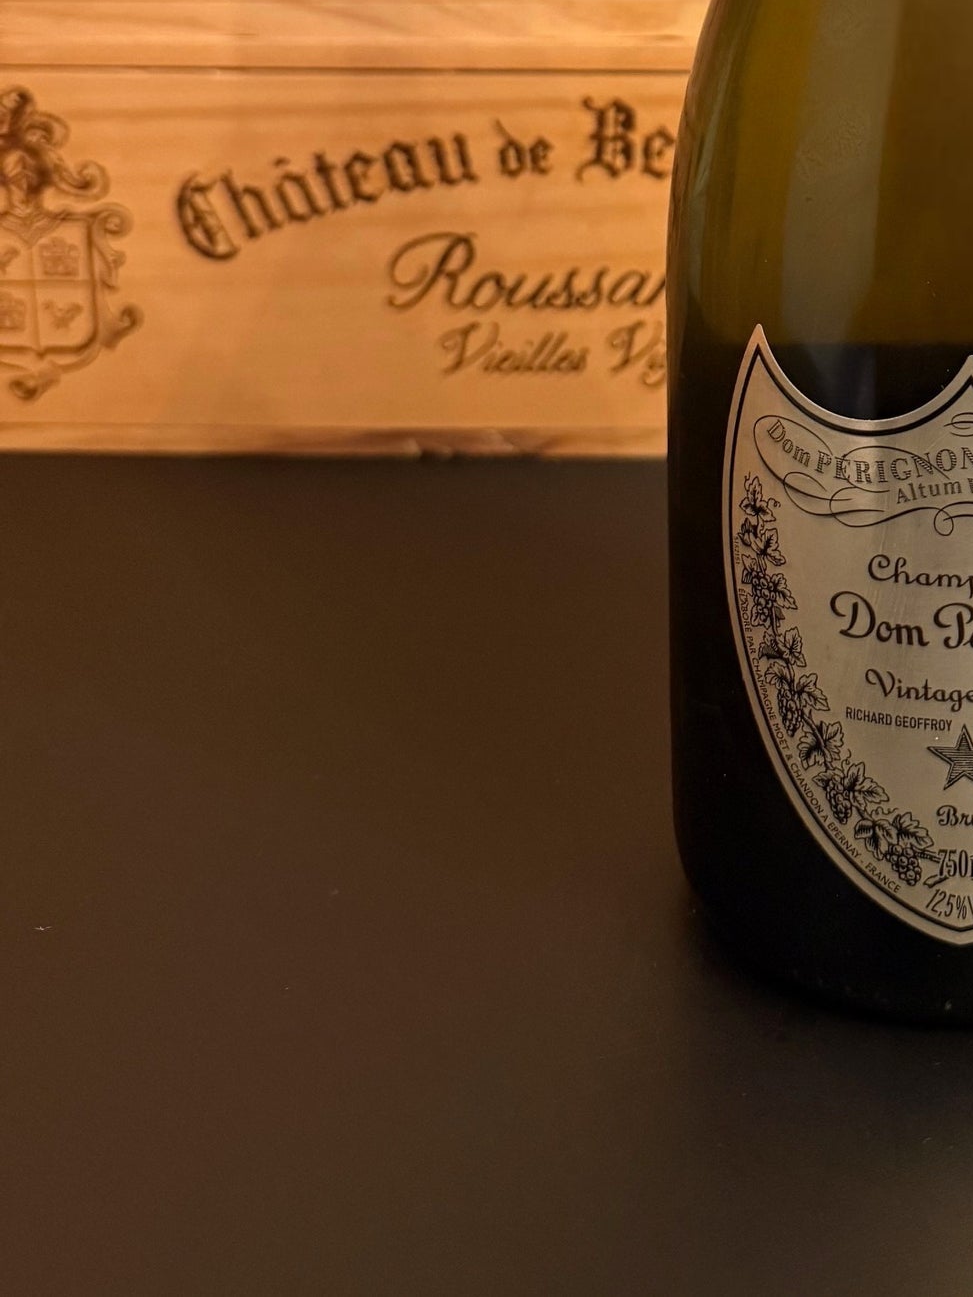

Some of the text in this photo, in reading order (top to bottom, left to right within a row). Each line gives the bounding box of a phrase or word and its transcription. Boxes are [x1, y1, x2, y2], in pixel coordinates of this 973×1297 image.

[175, 131, 480, 262] Château
[494, 117, 556, 179] de
[440, 319, 592, 376] Vieilles
[766, 418, 812, 469] Dom
[895, 479, 963, 504] Altum
[746, 634, 757, 655] PAR
[829, 590, 930, 648] Dom
[751, 657, 777, 721] CHAMPAGNE
[845, 706, 953, 732] RICHARD GEOFFROY
[790, 762, 825, 814] CHANDON
[864, 861, 902, 894] FRANCE
